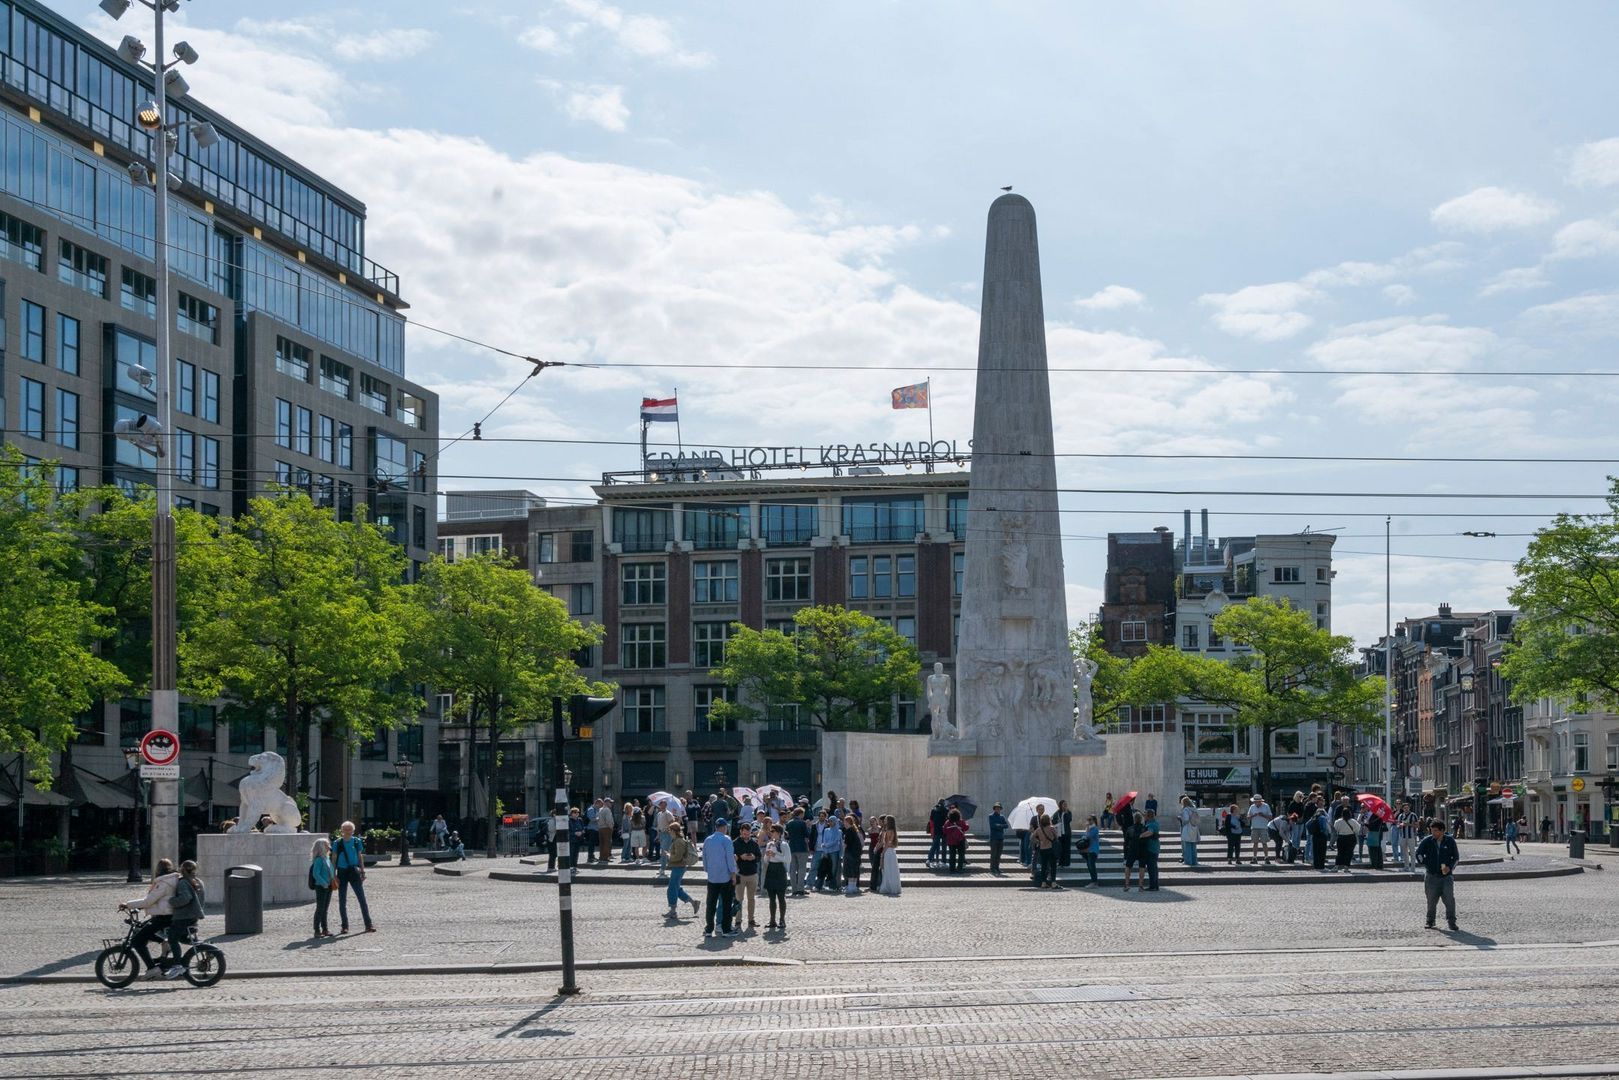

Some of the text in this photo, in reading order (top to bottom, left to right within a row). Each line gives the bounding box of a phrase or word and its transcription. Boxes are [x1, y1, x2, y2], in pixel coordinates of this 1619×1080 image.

[646, 450, 724, 471] GRAND
[732, 446, 810, 468] HOTEL
[1187, 769, 1218, 778] TE HUUR
